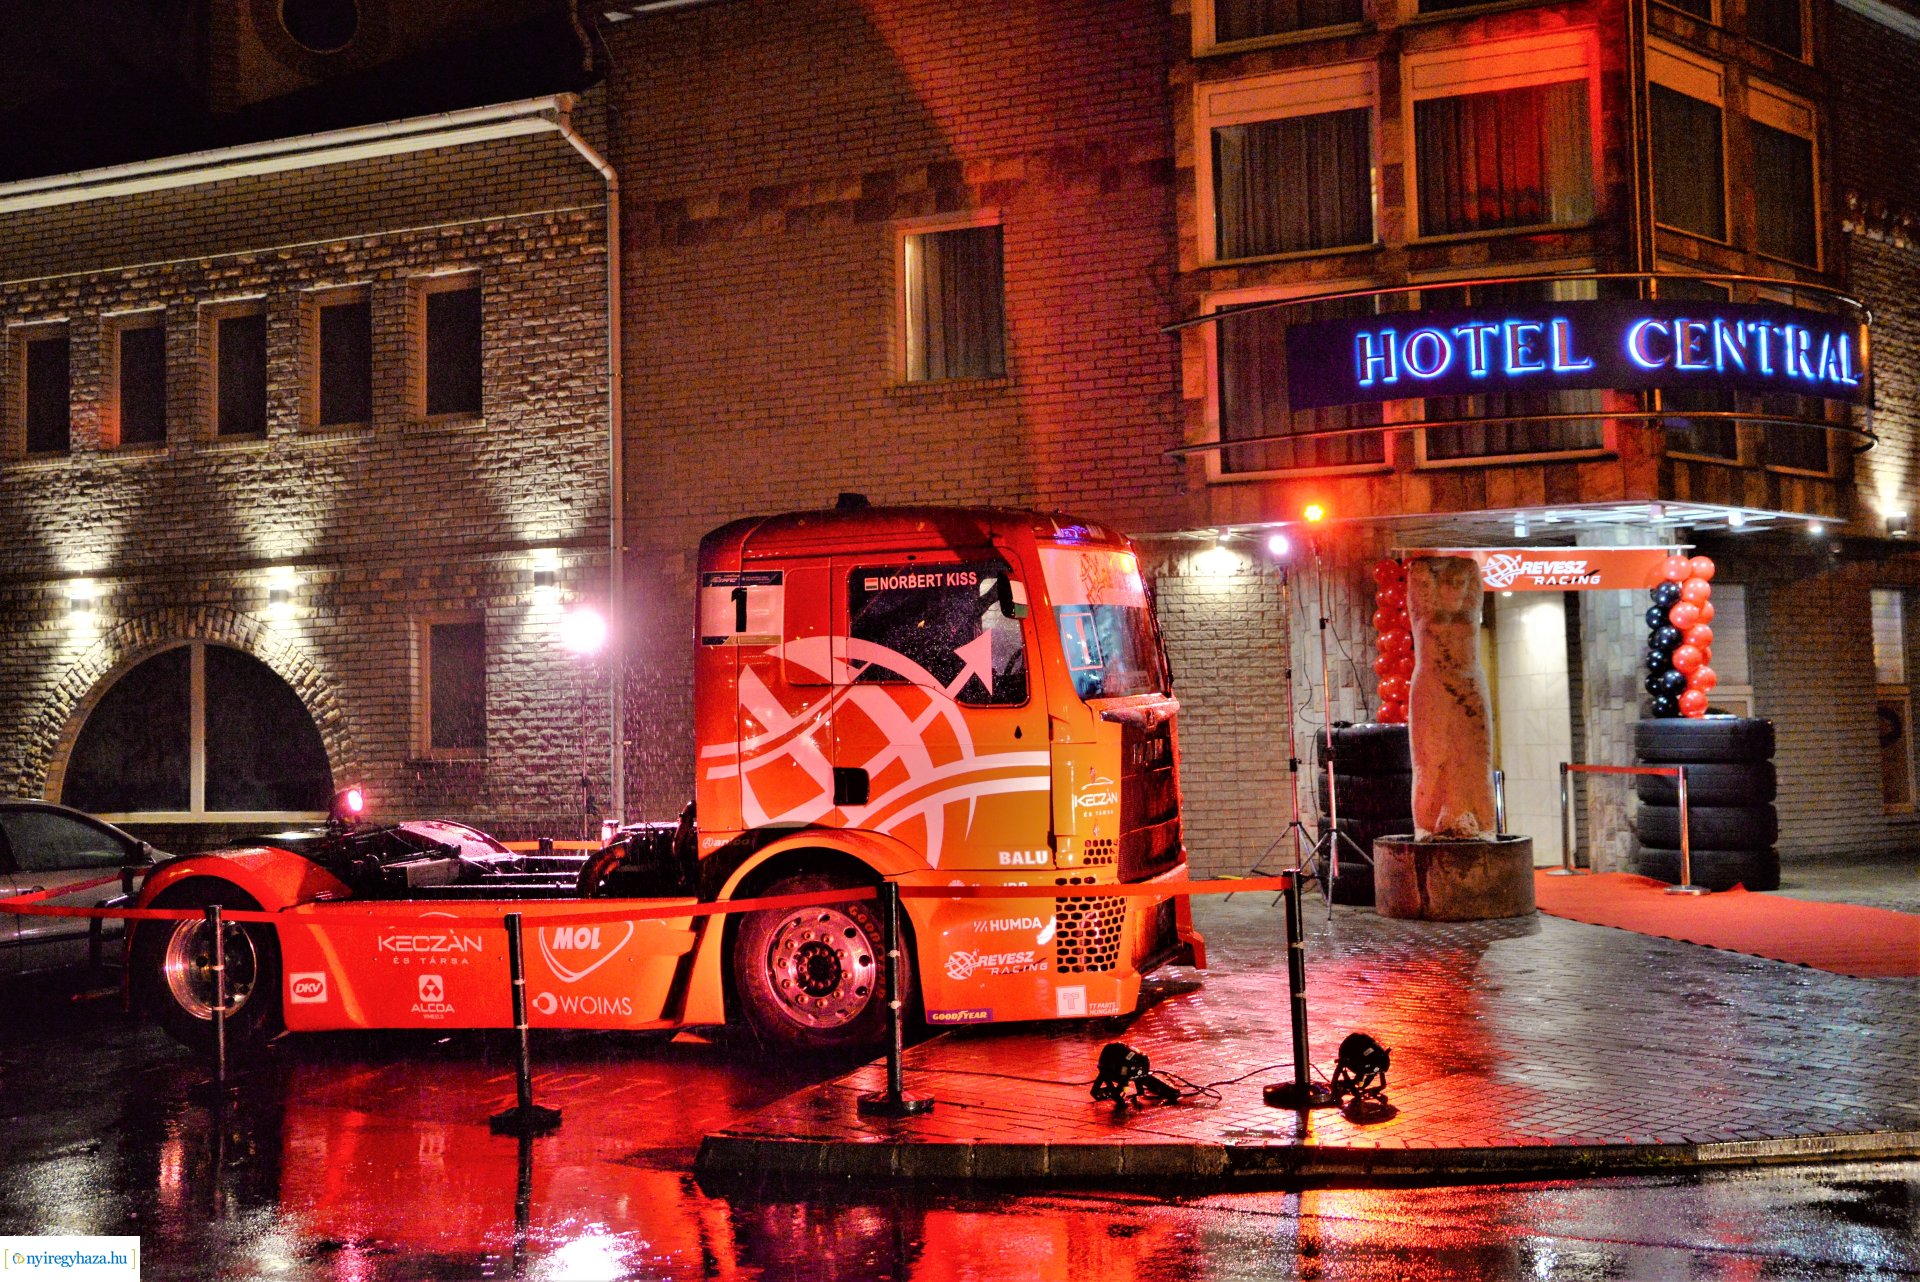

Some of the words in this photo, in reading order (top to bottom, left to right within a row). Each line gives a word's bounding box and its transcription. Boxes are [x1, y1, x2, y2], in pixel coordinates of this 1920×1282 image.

[1356, 317, 1595, 386] HOTEL
[1629, 317, 1863, 386] CENTRAL
[1520, 560, 1588, 575] REVESZ
[880, 573, 943, 590] NORBERT
[946, 571, 978, 587] KISS
[1534, 574, 1601, 586] RACING
[731, 588, 747, 633] 1
[998, 850, 1049, 865] BALU
[990, 916, 1042, 933] HUMDA
[552, 927, 602, 950] MOL
[393, 956, 410, 965] ÉS
[420, 956, 469, 965] TÁRSA
[978, 951, 1035, 968] REVESZ
[991, 963, 1048, 976] RACING
[295, 982, 322, 994] DKV
[411, 1003, 455, 1013] ALCOA
[559, 995, 632, 1016] WOIMS
[932, 1010, 988, 1022] GOODYEAR
